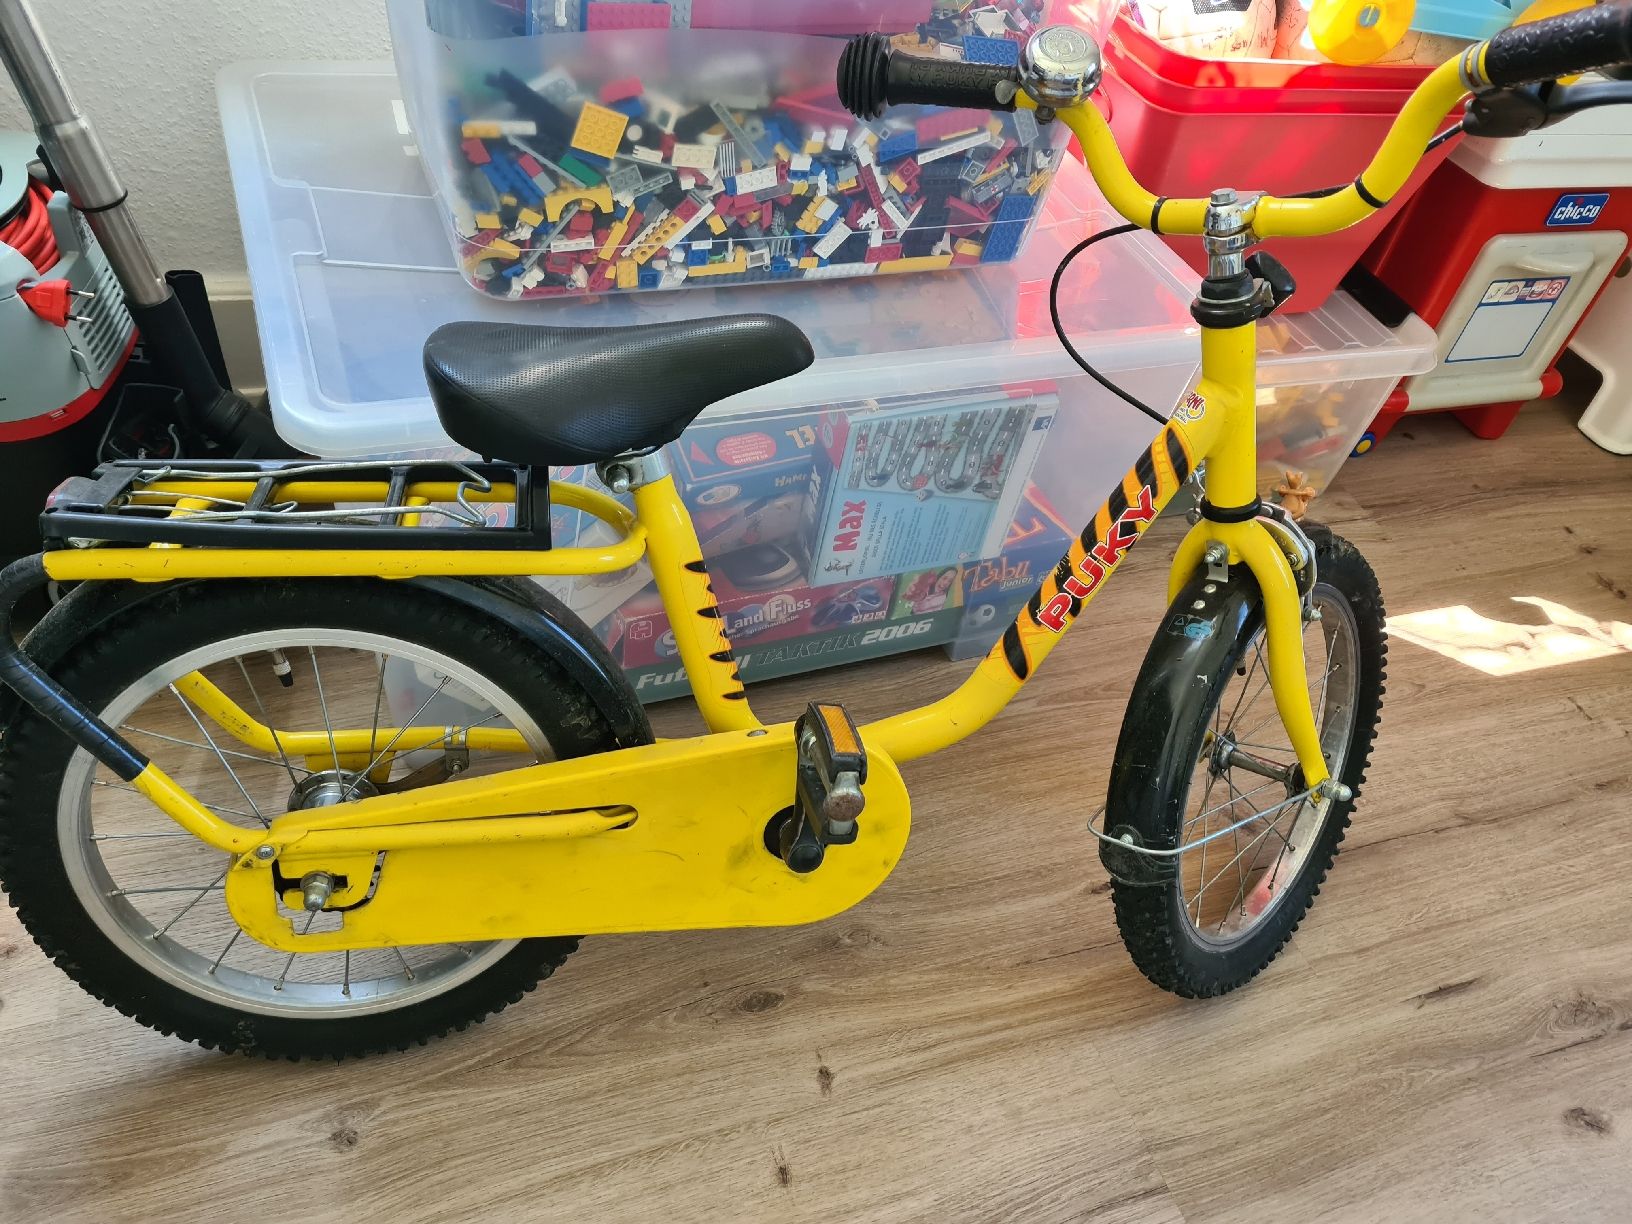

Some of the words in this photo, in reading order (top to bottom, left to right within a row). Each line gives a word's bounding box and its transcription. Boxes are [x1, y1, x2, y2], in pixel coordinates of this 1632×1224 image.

[1554, 201, 1600, 220] chicco
[963, 556, 1031, 593] Tabu
[1037, 485, 1158, 632] PUKY
[768, 596, 812, 622] Fluss
[756, 632, 861, 666] TAKTIK
[861, 618, 934, 647] 2006
